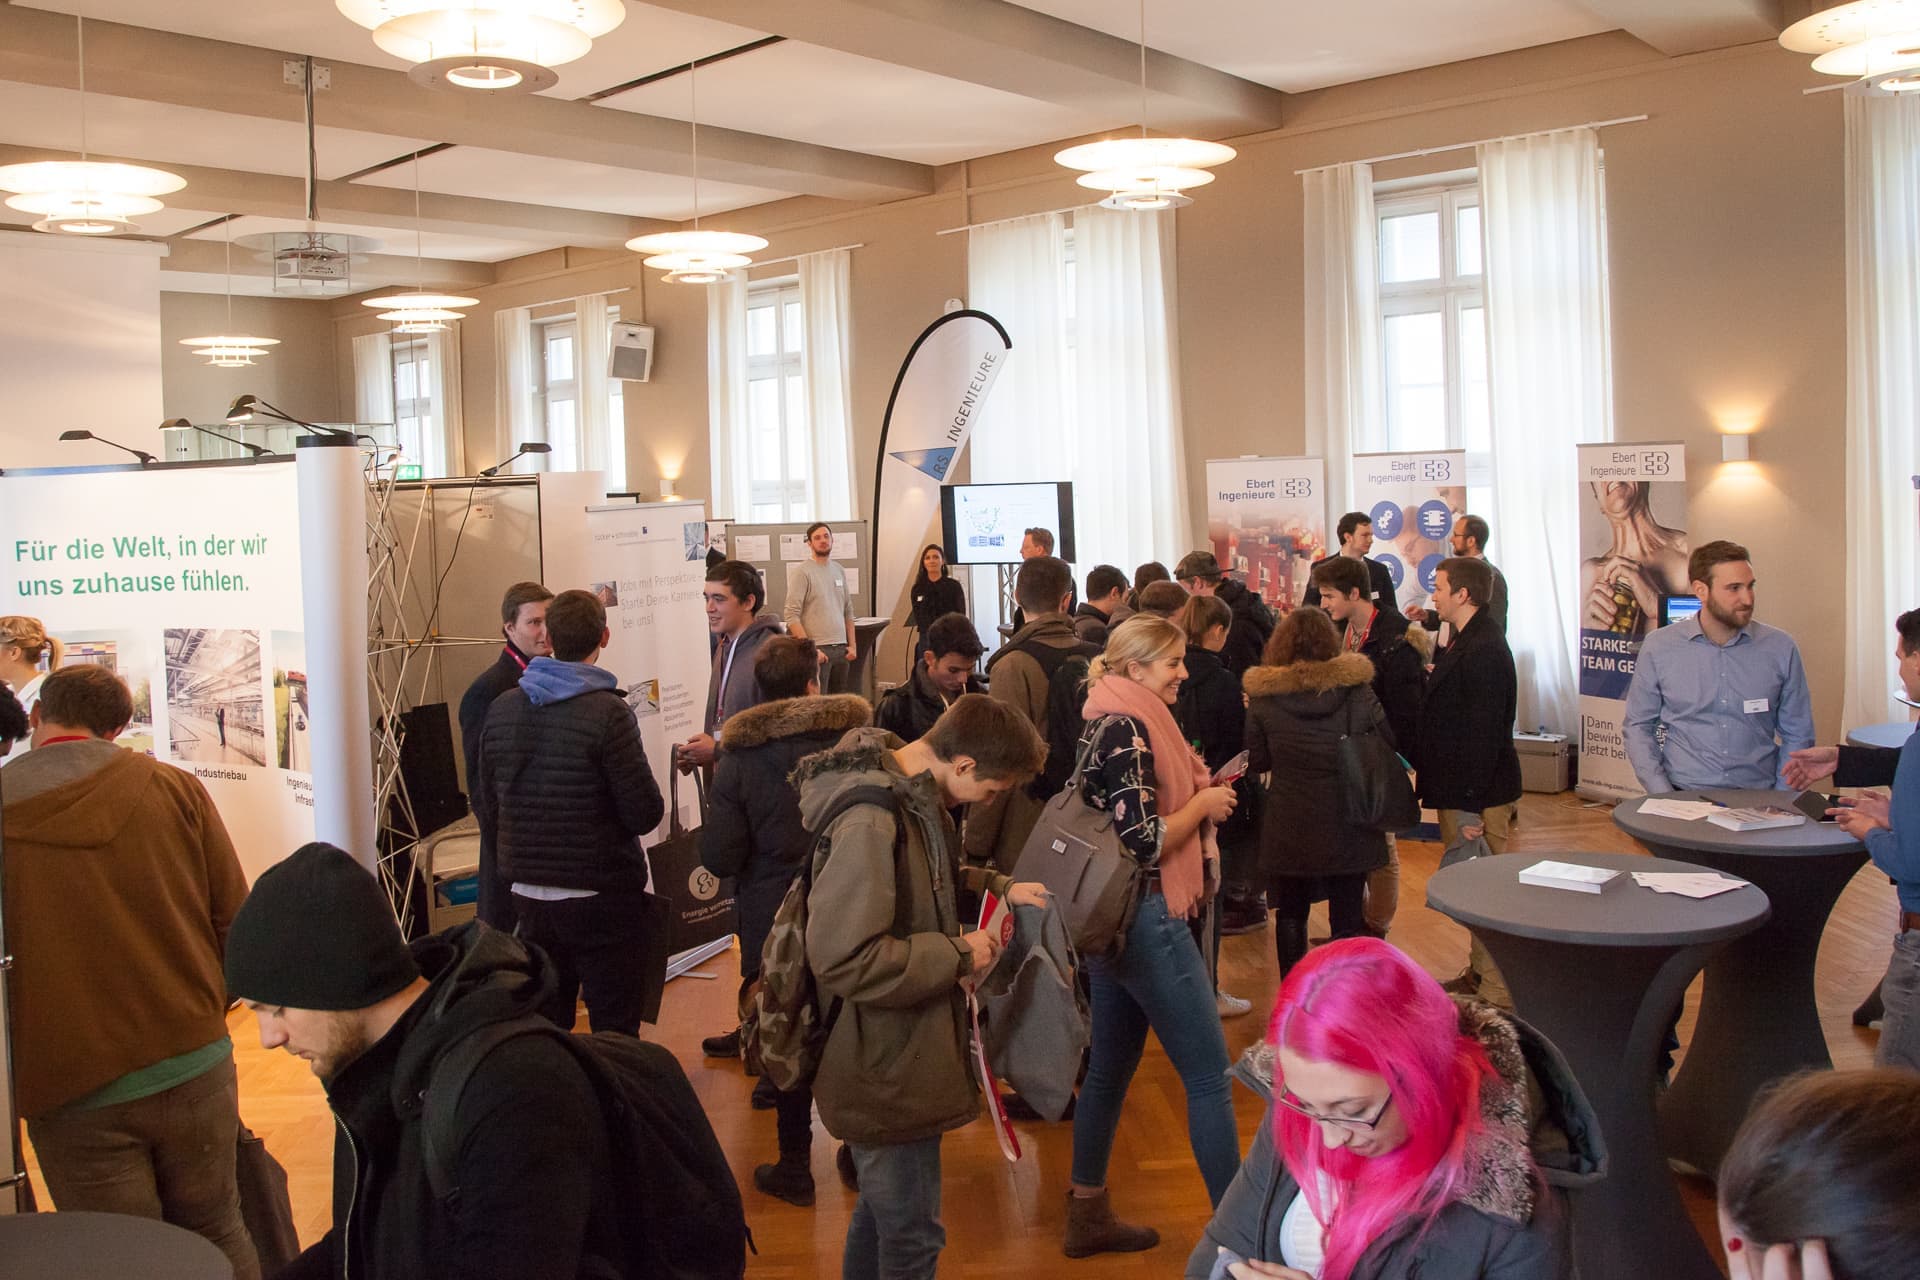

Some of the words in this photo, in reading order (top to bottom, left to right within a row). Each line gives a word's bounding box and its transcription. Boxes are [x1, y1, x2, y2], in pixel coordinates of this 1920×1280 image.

[933, 454, 949, 475] RS
[946, 351, 998, 443] INGENIEURE
[1612, 452, 1636, 463] Ebert
[1391, 460, 1416, 471] Ebert
[1590, 466, 1636, 478] Ingenieure
[1246, 479, 1275, 489] Ebert
[1368, 473, 1416, 485] Ingenieure
[1219, 490, 1275, 502] Ingenieure
[15, 540, 58, 562] Für
[66, 538, 105, 560] die
[112, 535, 172, 560] Welt,
[178, 535, 197, 556] in
[203, 533, 235, 556] der
[241, 533, 267, 555] wir
[18, 578, 64, 596] uns
[72, 572, 175, 594] zuhause
[182, 569, 249, 592] fühlen.
[1582, 655, 1615, 671] TEAM
[1618, 659, 1637, 674] GE
[1587, 716, 1614, 731] Dann
[1587, 729, 1622, 746] bewirb
[1586, 742, 1609, 757] jetzt
[1611, 747, 1626, 760] bei
[194, 767, 247, 781] Industriebau
